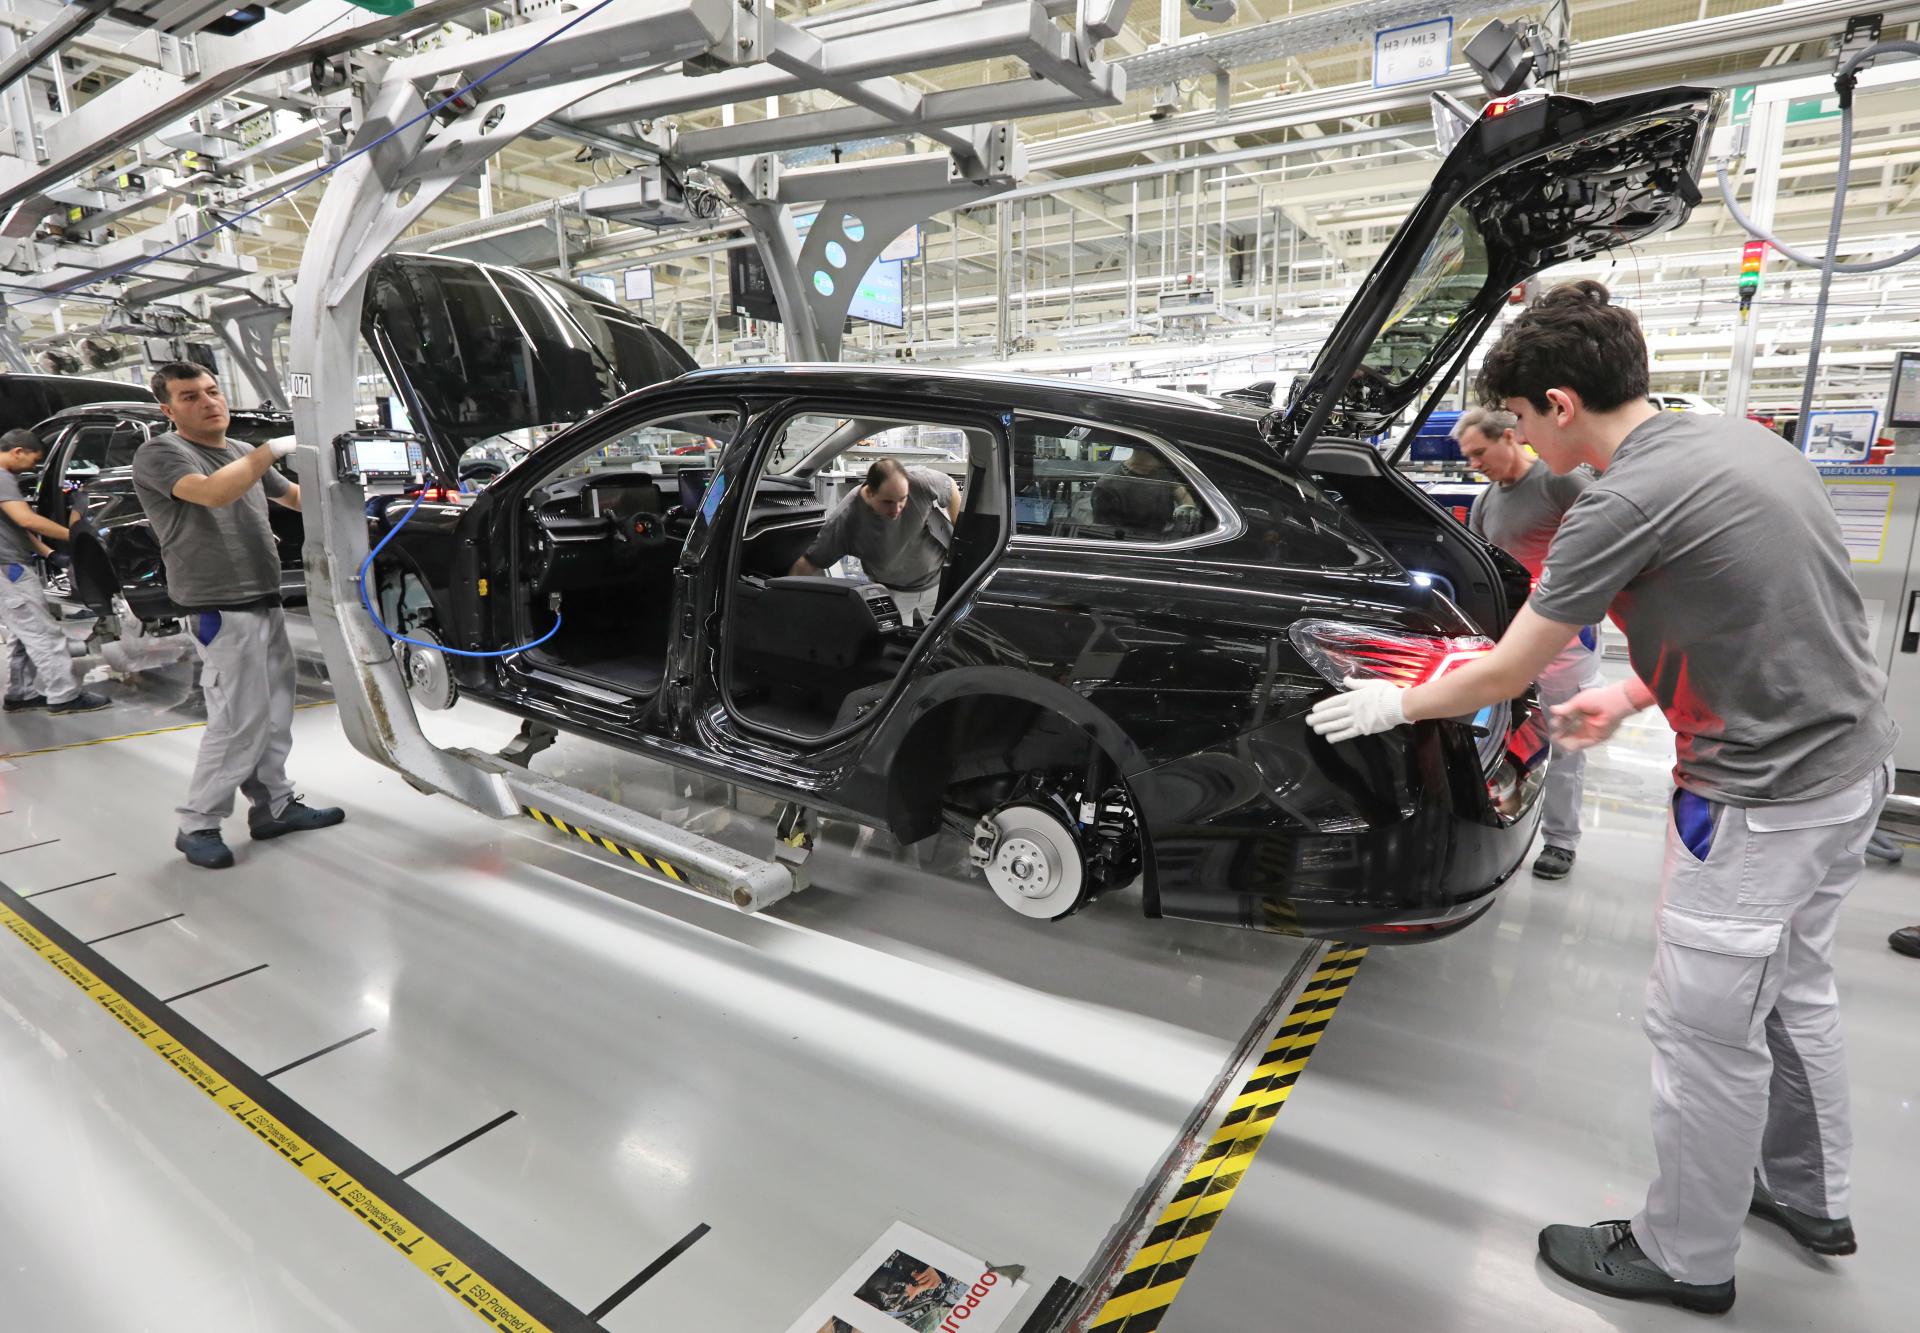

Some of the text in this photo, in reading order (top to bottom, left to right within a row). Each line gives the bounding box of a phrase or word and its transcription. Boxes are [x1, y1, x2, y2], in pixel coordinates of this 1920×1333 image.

[1384, 40, 1399, 51] H3
[1411, 32, 1436, 48] ML3
[294, 375, 309, 395] 071
[348, 1189, 406, 1236] ESD Protected Area
[469, 1284, 491, 1302] ESD
[486, 1298, 527, 1330] Protected
